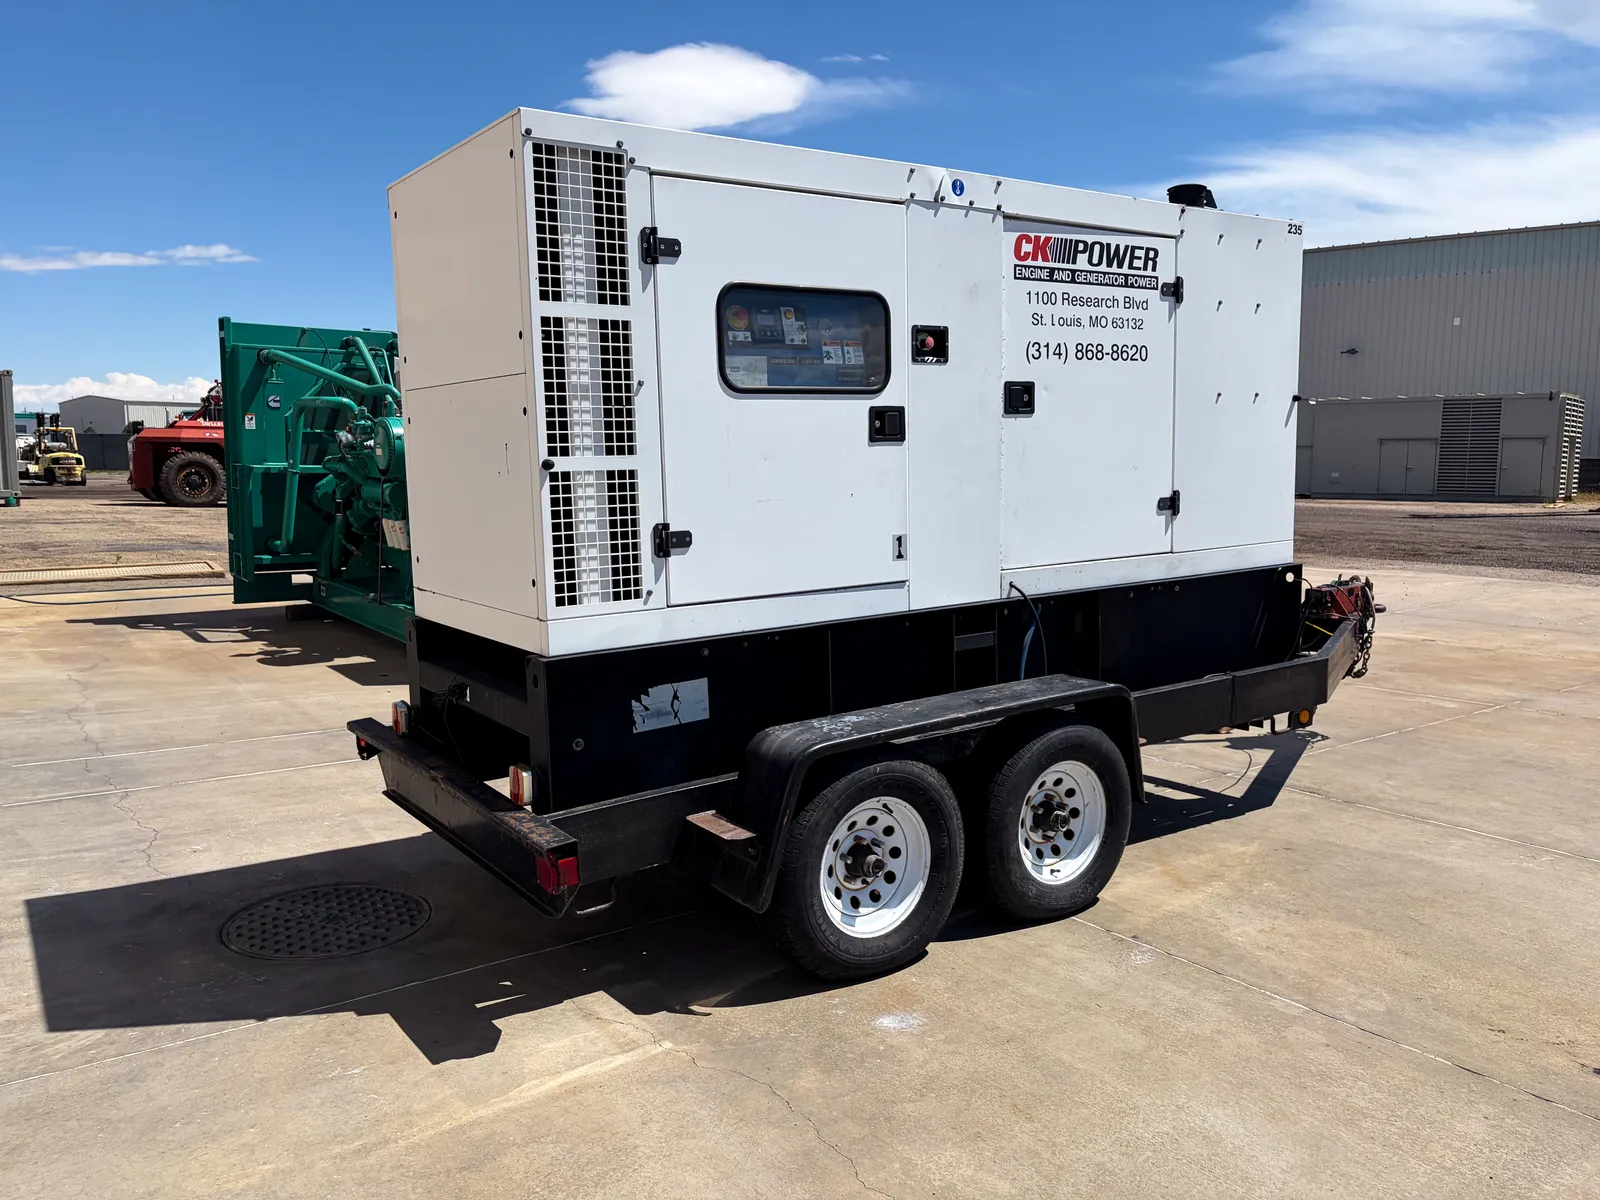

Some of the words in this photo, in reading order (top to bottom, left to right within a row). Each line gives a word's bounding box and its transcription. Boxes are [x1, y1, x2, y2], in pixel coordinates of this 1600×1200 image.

[1287, 223, 1303, 236] 235
[1013, 233, 1053, 263] CK
[1071, 239, 1160, 273] POWER
[1015, 266, 1050, 280] ENGINE
[1053, 270, 1072, 281] AND
[1075, 272, 1125, 286] GENERATOR
[1127, 278, 1157, 289] POWER
[1026, 290, 1057, 306] 1100
[1061, 292, 1119, 309] Research
[1123, 296, 1149, 311] Blvd
[1031, 312, 1047, 326] St.
[1051, 313, 1085, 330] Louis,
[1089, 315, 1108, 329] MO
[1111, 317, 1144, 330] 63132
[1026, 341, 1068, 365] (314)
[1075, 343, 1149, 362] 868-8620
